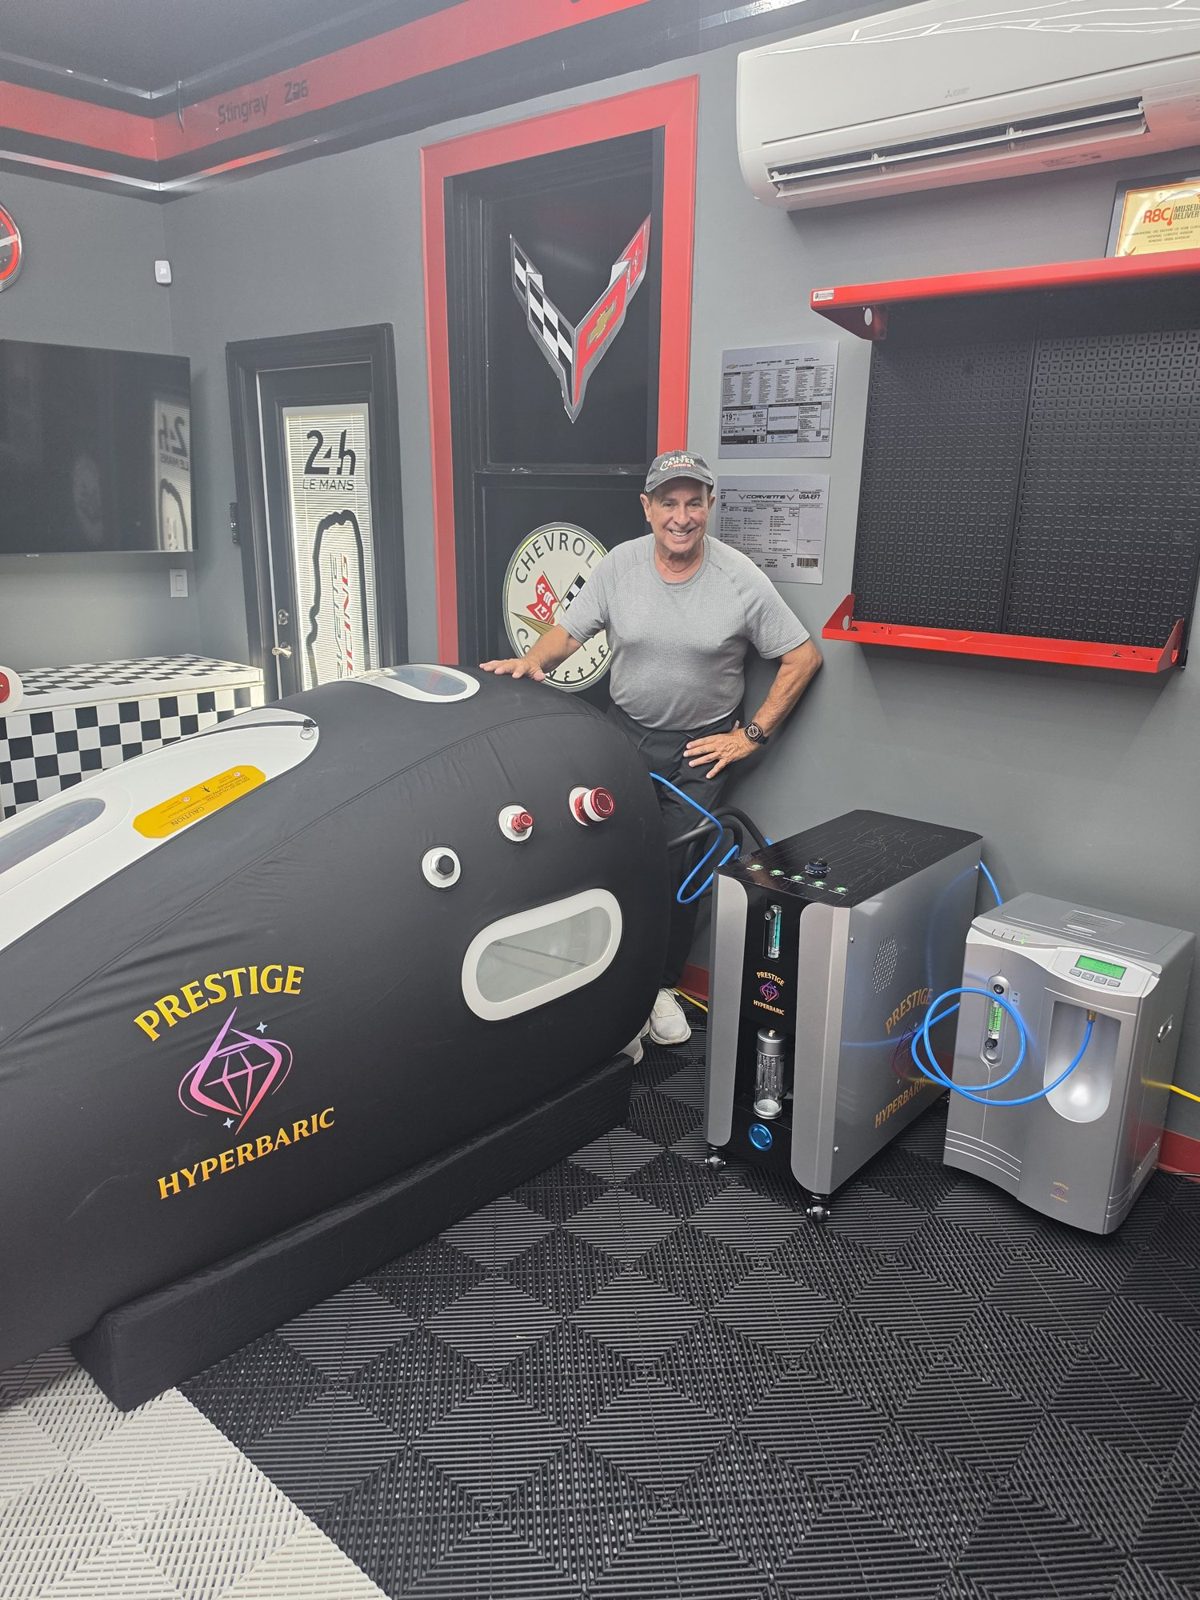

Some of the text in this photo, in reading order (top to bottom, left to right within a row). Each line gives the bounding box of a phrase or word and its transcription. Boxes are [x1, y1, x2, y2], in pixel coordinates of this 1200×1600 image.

[218, 94, 270, 124] Stingray
[1173, 211, 1200, 220] DELIVER
[1174, 204, 1200, 213] MUSEU
[304, 429, 357, 476] 24h
[302, 479, 355, 491] LE MANS
[515, 532, 596, 584] CHEVROL
[756, 971, 785, 987] PRESTIGE
[133, 964, 305, 1042] PRESTIGE
[753, 999, 785, 1016] HYPERBARIC
[884, 987, 934, 1035] PRESTIGE
[875, 1076, 926, 1129] HYPERBARI
[157, 1106, 336, 1200] HYPERBARIC
